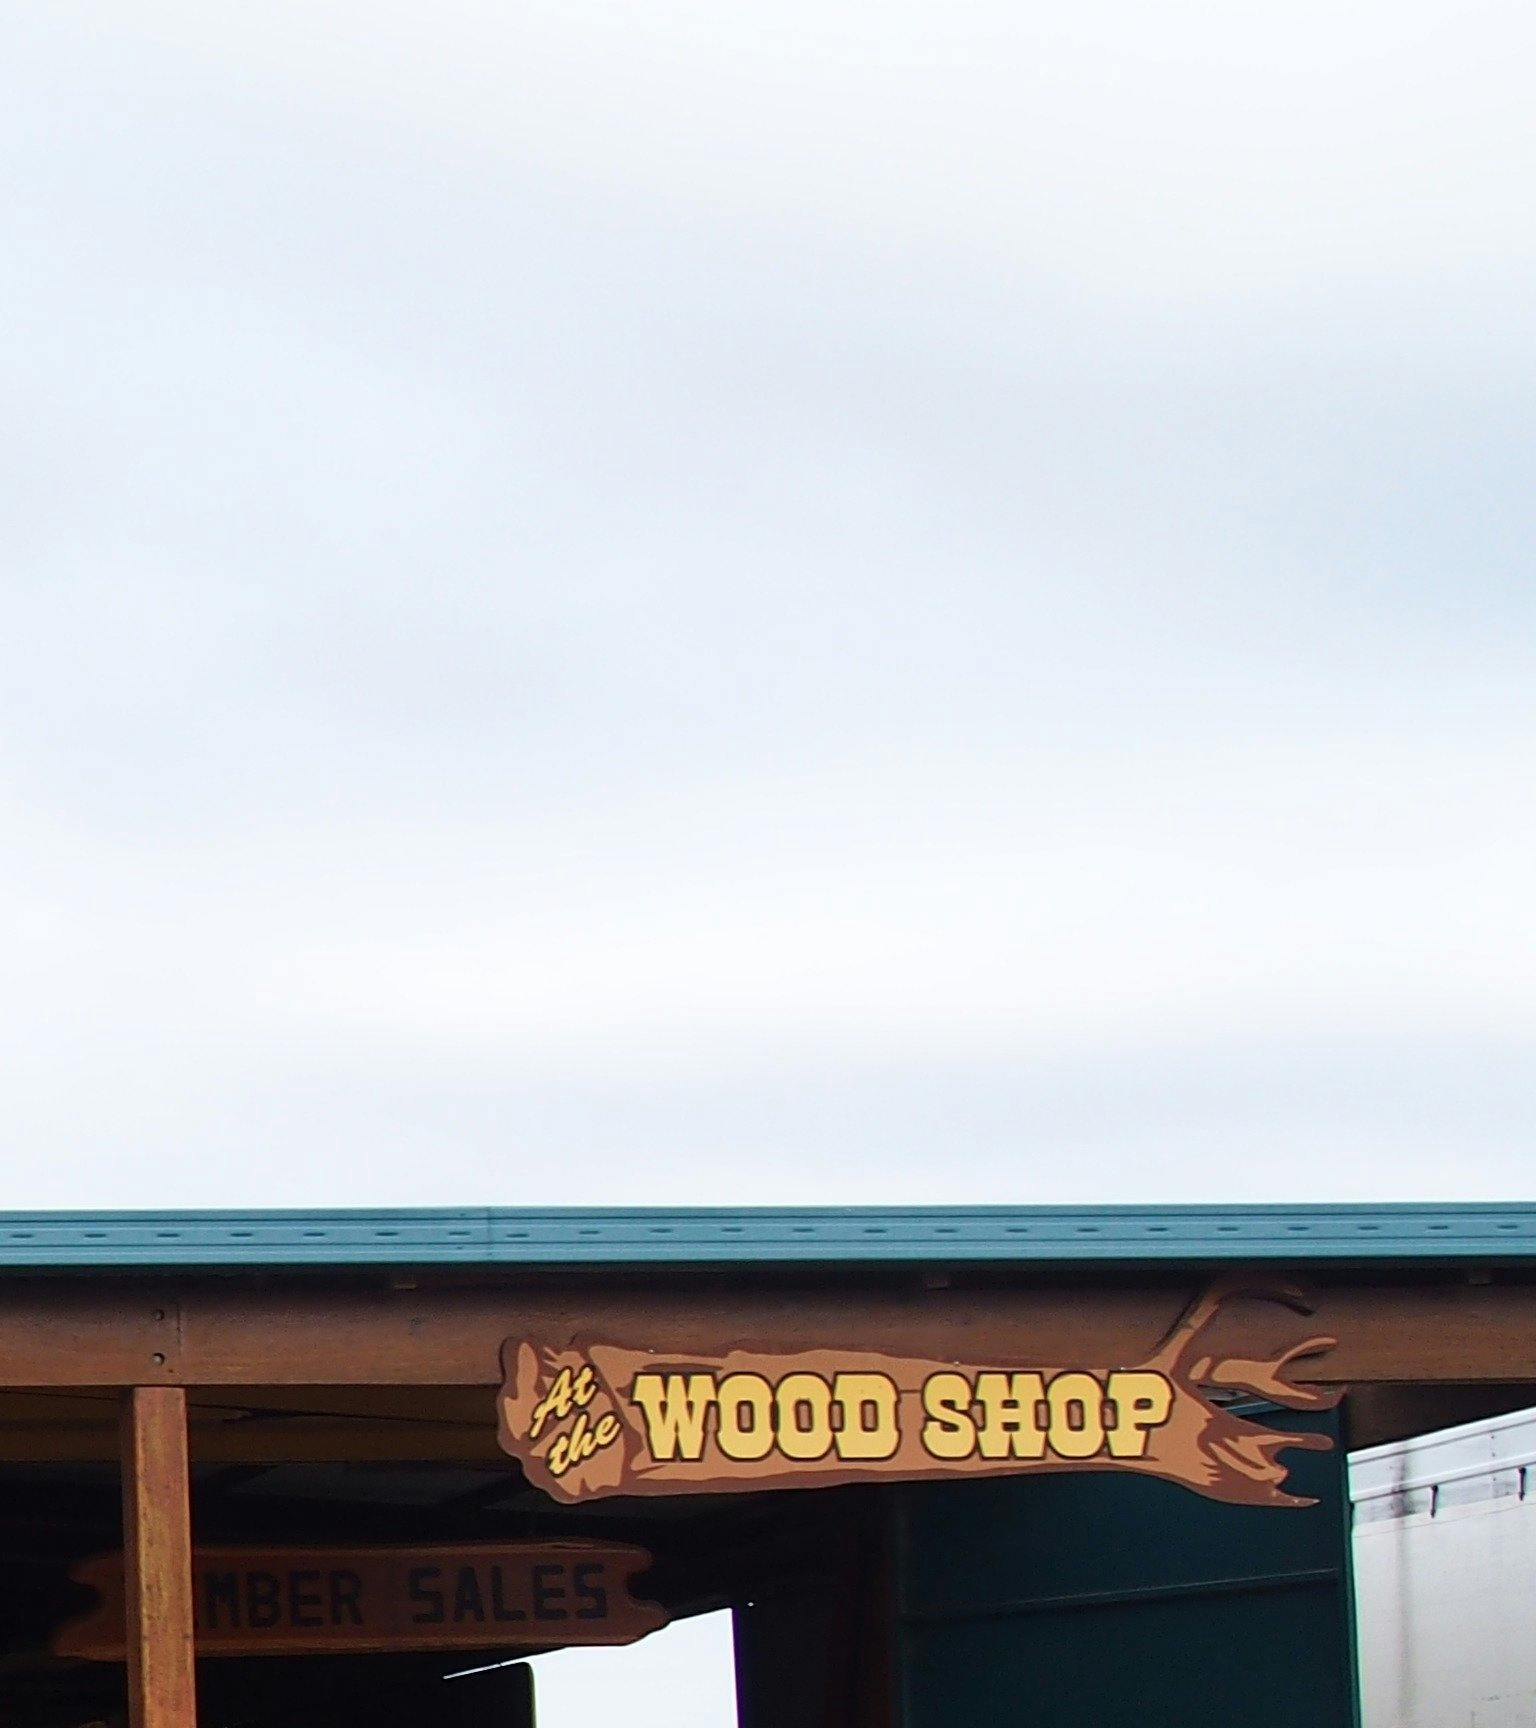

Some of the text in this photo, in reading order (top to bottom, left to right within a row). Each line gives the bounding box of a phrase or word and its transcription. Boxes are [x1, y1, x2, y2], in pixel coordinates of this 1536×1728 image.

[529, 1366, 598, 1438] At
[632, 1371, 1174, 1460] WOOD SHOP
[547, 1413, 621, 1475] the
[408, 1562, 610, 1626] SALES
